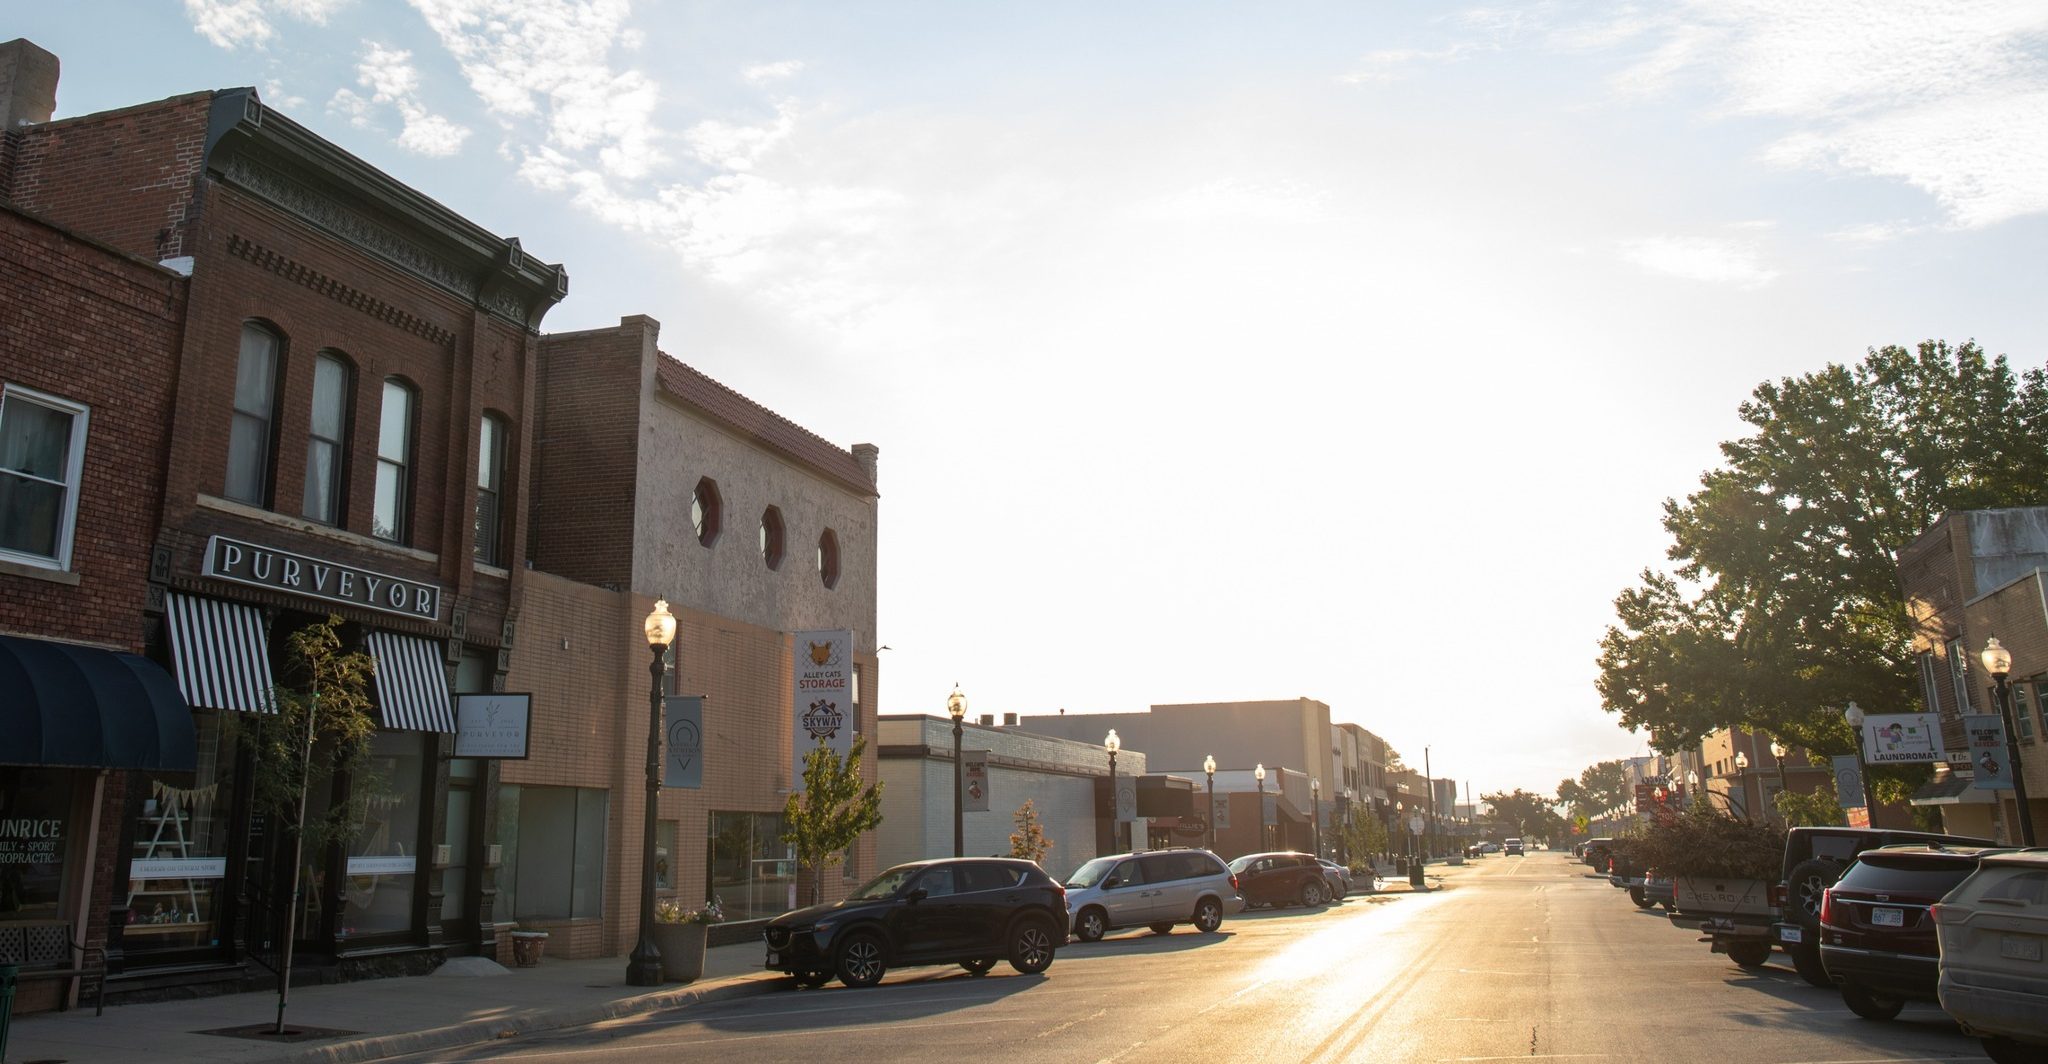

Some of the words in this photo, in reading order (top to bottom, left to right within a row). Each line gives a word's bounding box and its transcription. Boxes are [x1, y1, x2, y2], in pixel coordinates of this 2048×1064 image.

[222, 544, 431, 614] PURVEYOR
[803, 671, 824, 679] ALLEY
[799, 679, 846, 689] STORAGE
[802, 716, 843, 727] SKYWAY
[1873, 752, 1939, 761] LAUNDROMAT
[27, 841, 56, 851] SPORT
